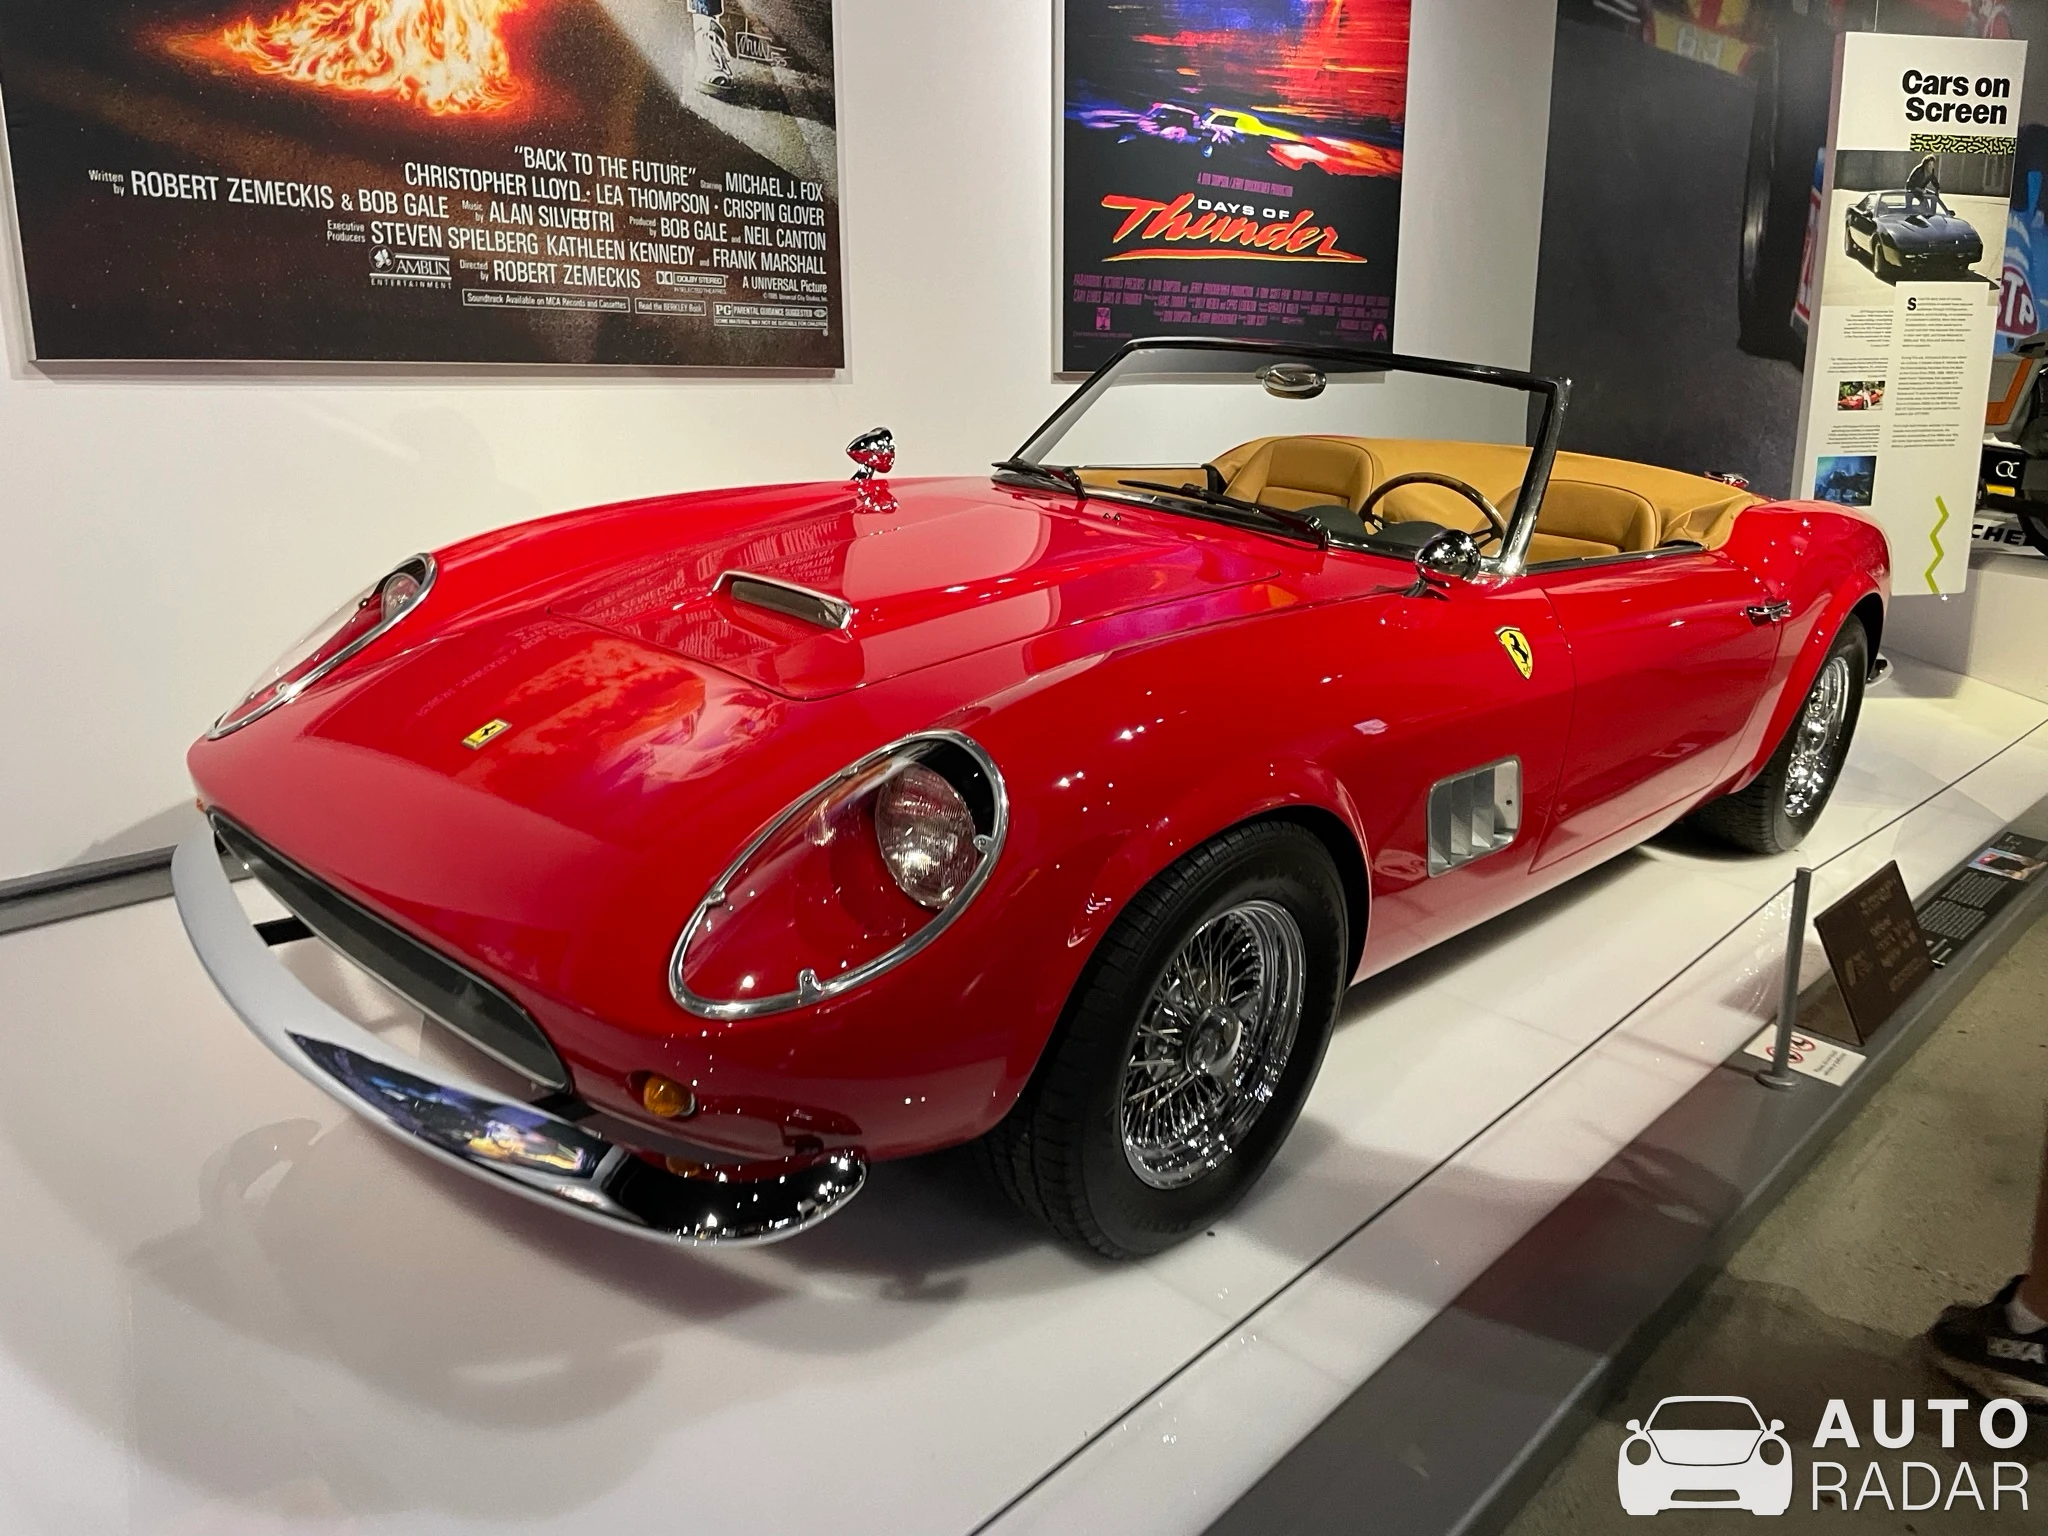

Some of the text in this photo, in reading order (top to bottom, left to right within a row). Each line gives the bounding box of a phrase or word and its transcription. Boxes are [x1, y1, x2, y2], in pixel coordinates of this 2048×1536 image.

[1902, 70, 2011, 98] Cars on
[1905, 97, 2007, 124] Screen
[88, 169, 124, 183] Written
[571, 152, 593, 175] TO
[597, 155, 628, 179] THE
[113, 170, 450, 219] by ROBERT ZEMECKIS & BOB GALE
[404, 162, 825, 226] CHRISTOPHER LLOYD LEA THOMPSON CRISPIN GLOVER
[700, 172, 824, 202] Starring MICHAEL J. FOX
[461, 200, 483, 211] Music
[475, 211, 484, 223] by
[489, 200, 533, 226] ALAN
[1197, 198, 1290, 220] DAYS OF
[327, 219, 365, 232] Executive
[629, 215, 657, 227] Produced
[1101, 192, 1368, 262] Thunder
[649, 217, 826, 251] by BOB GALE and NEIL CANTON
[327, 220, 827, 275] Producers STEVEN SPIELBERG KATHLEEN KENNEDY and FRANK MARSHALL
[396, 259, 450, 276] AMBLIN
[459, 259, 489, 271] Directed
[480, 259, 641, 289] by ROBERT ZEMECKIS
[371, 278, 452, 289] ENTERTAINMENT
[676, 275, 723, 285] DOLBY STEREO
[742, 275, 827, 293] A UNIVERSAL Picture
[467, 292, 503, 304] Soundtrack
[505, 294, 536, 305] Available
[546, 296, 561, 306] MCA
[562, 297, 586, 308] Records
[587, 299, 597, 308] and
[599, 299, 627, 309] Cassettes
[638, 301, 702, 313] Read the BERKLEY Book
[1998, 271, 2035, 327] TP
[715, 304, 813, 318] PG PARENTAL GUIDANCE SUGGESTED
